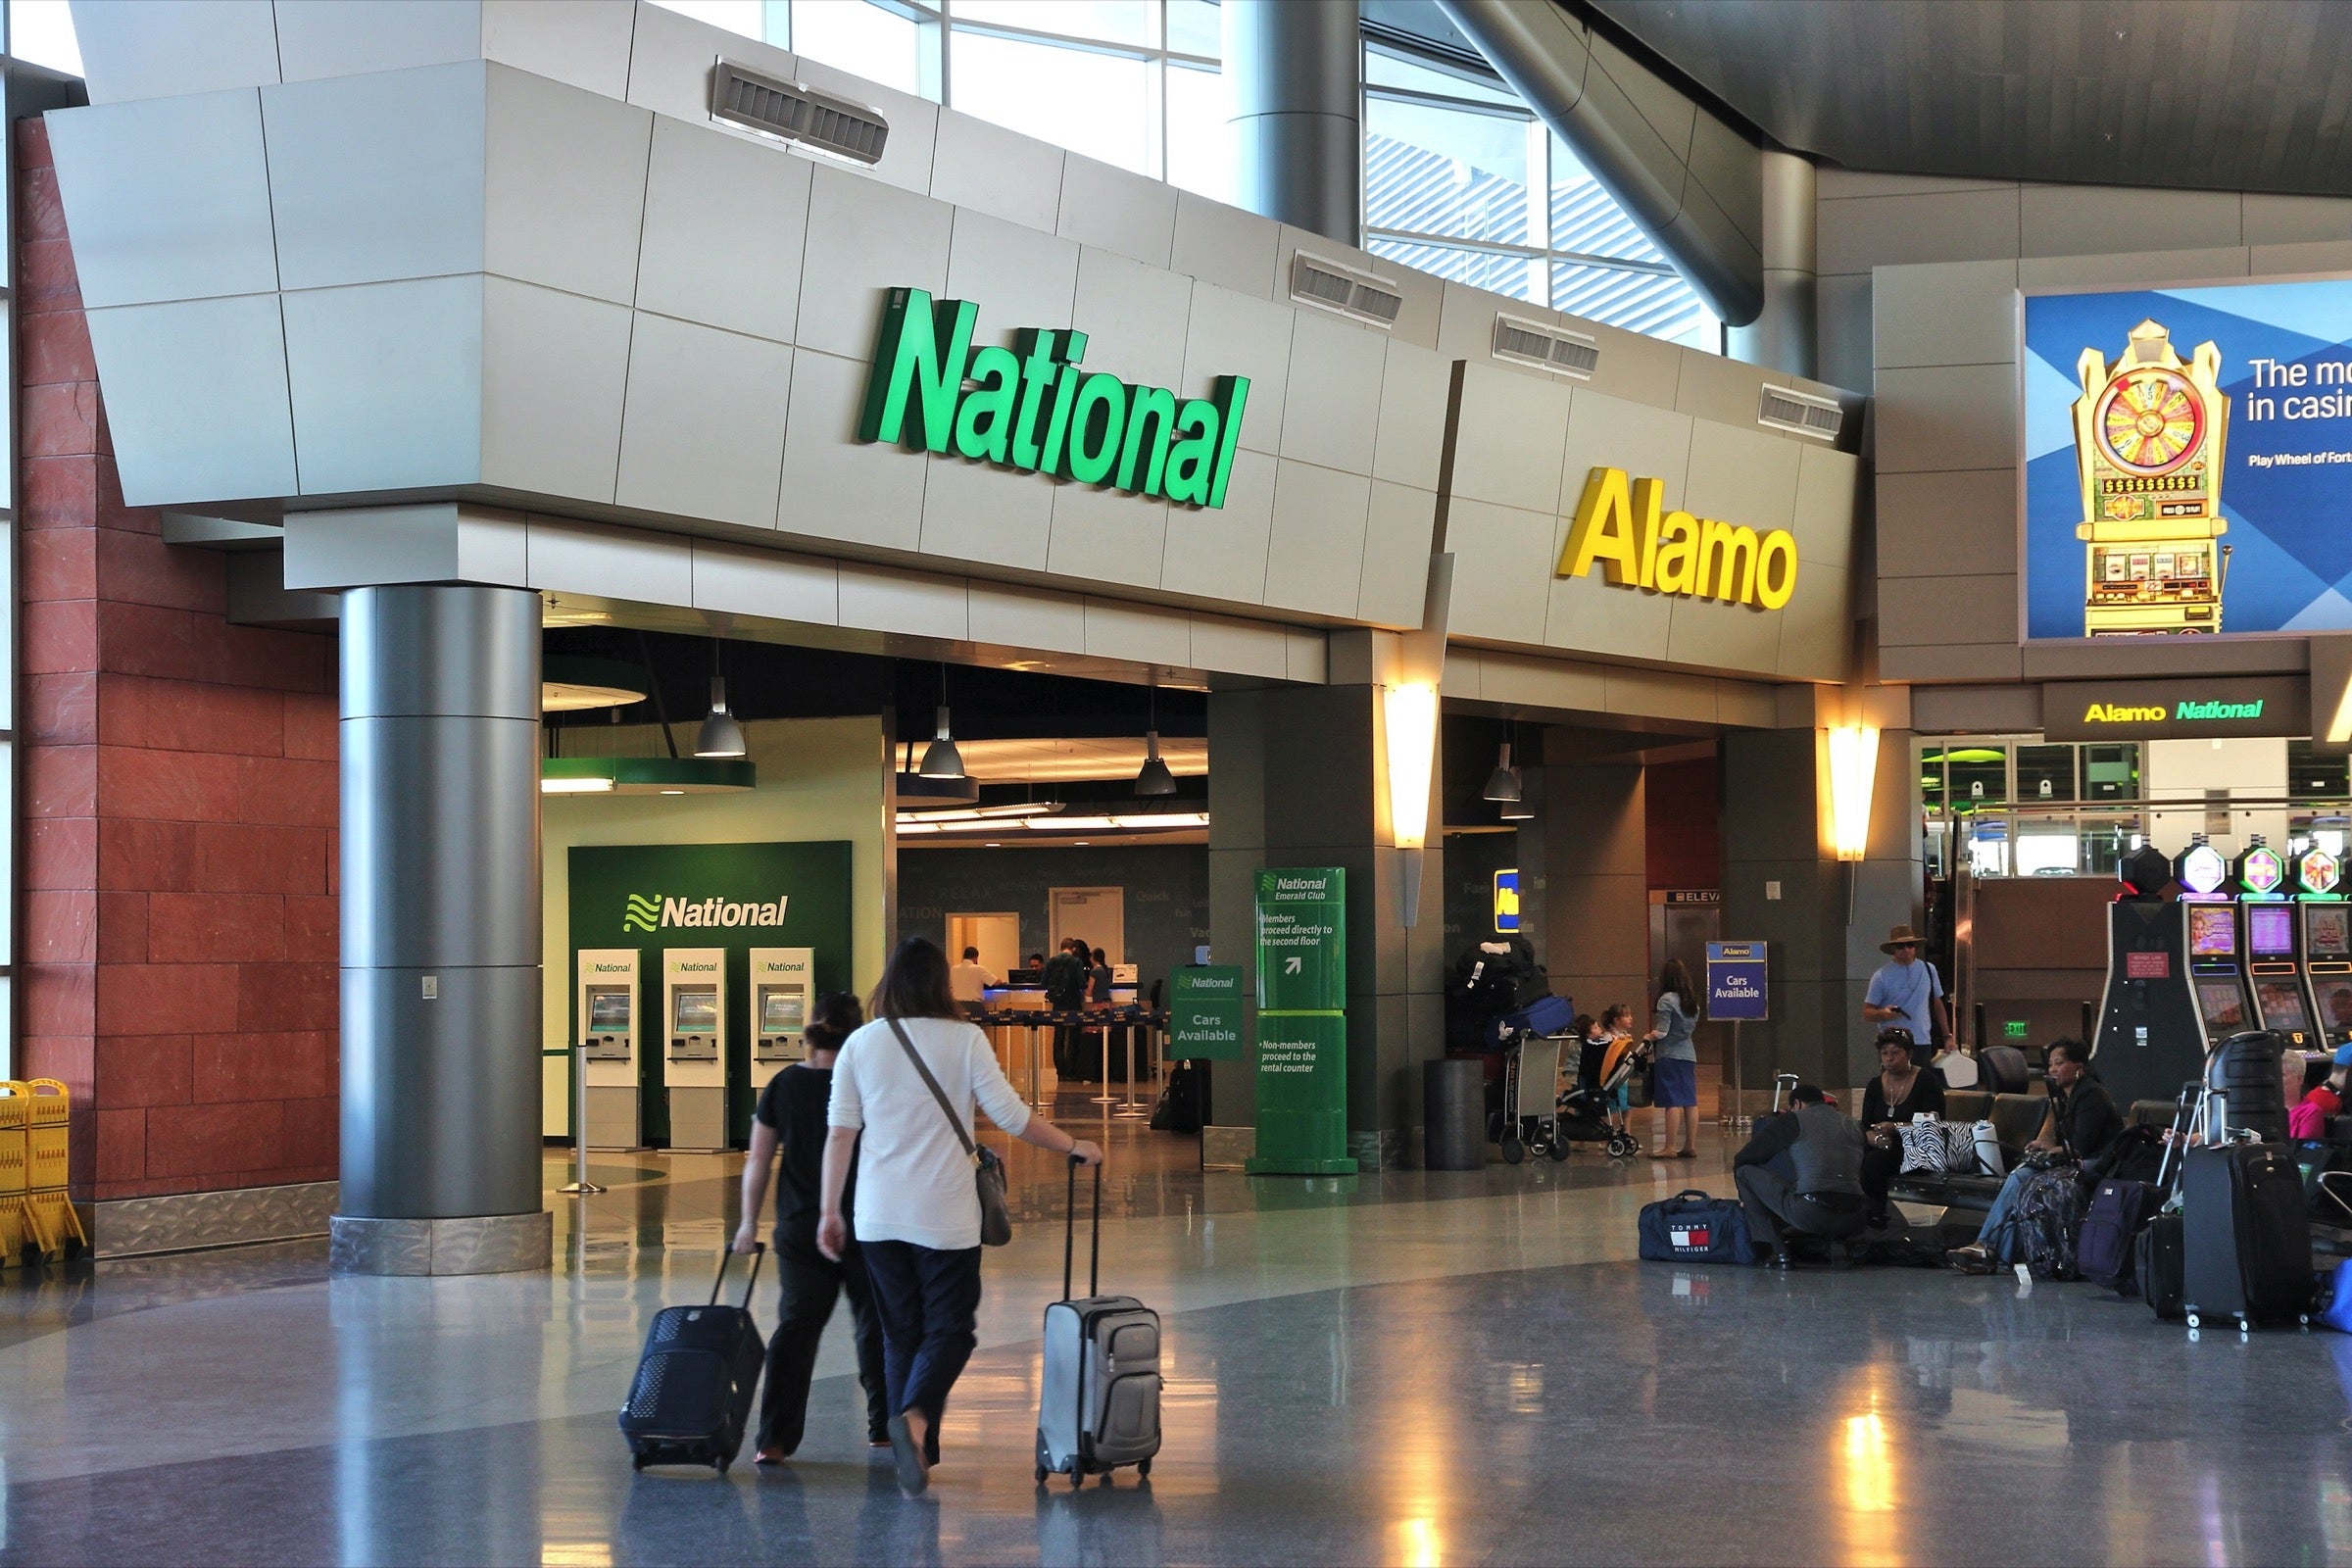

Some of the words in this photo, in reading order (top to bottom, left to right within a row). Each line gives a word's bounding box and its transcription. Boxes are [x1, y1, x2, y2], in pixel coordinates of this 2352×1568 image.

[2248, 359, 2308, 388] The
[862, 287, 1250, 510] National
[2248, 392, 2275, 421] in
[2248, 454, 2274, 468] Play
[2275, 452, 2312, 466] Wheel
[2313, 451, 2327, 465] of
[1557, 466, 1797, 610] Alamo
[2083, 704, 2167, 723] Alamo
[2175, 700, 2264, 720] National
[1277, 878, 1327, 890] National
[1275, 892, 1306, 901] Emerald
[1307, 891, 1326, 900] Club
[661, 895, 789, 928] National
[1261, 913, 1296, 923] Members
[1261, 925, 1291, 935] proceed
[1292, 924, 1322, 936] directly
[1323, 925, 1333, 934] to
[1260, 937, 1271, 946] the
[1272, 937, 1298, 946] second
[1300, 937, 1320, 946] floor
[595, 962, 631, 973] National
[680, 962, 717, 972] National
[767, 961, 805, 972] National
[1192, 978, 1234, 988] National
[1726, 975, 1747, 986] Cars
[1715, 988, 1759, 998] Available
[1193, 1014, 1221, 1025] Cars
[2008, 1022, 2025, 1034] EXIT
[1177, 1030, 1236, 1041] Available
[1262, 1040, 1316, 1050] Non-members
[1261, 1052, 1292, 1062] proceed
[1302, 1052, 1316, 1060] the
[1260, 1063, 1282, 1072] rental
